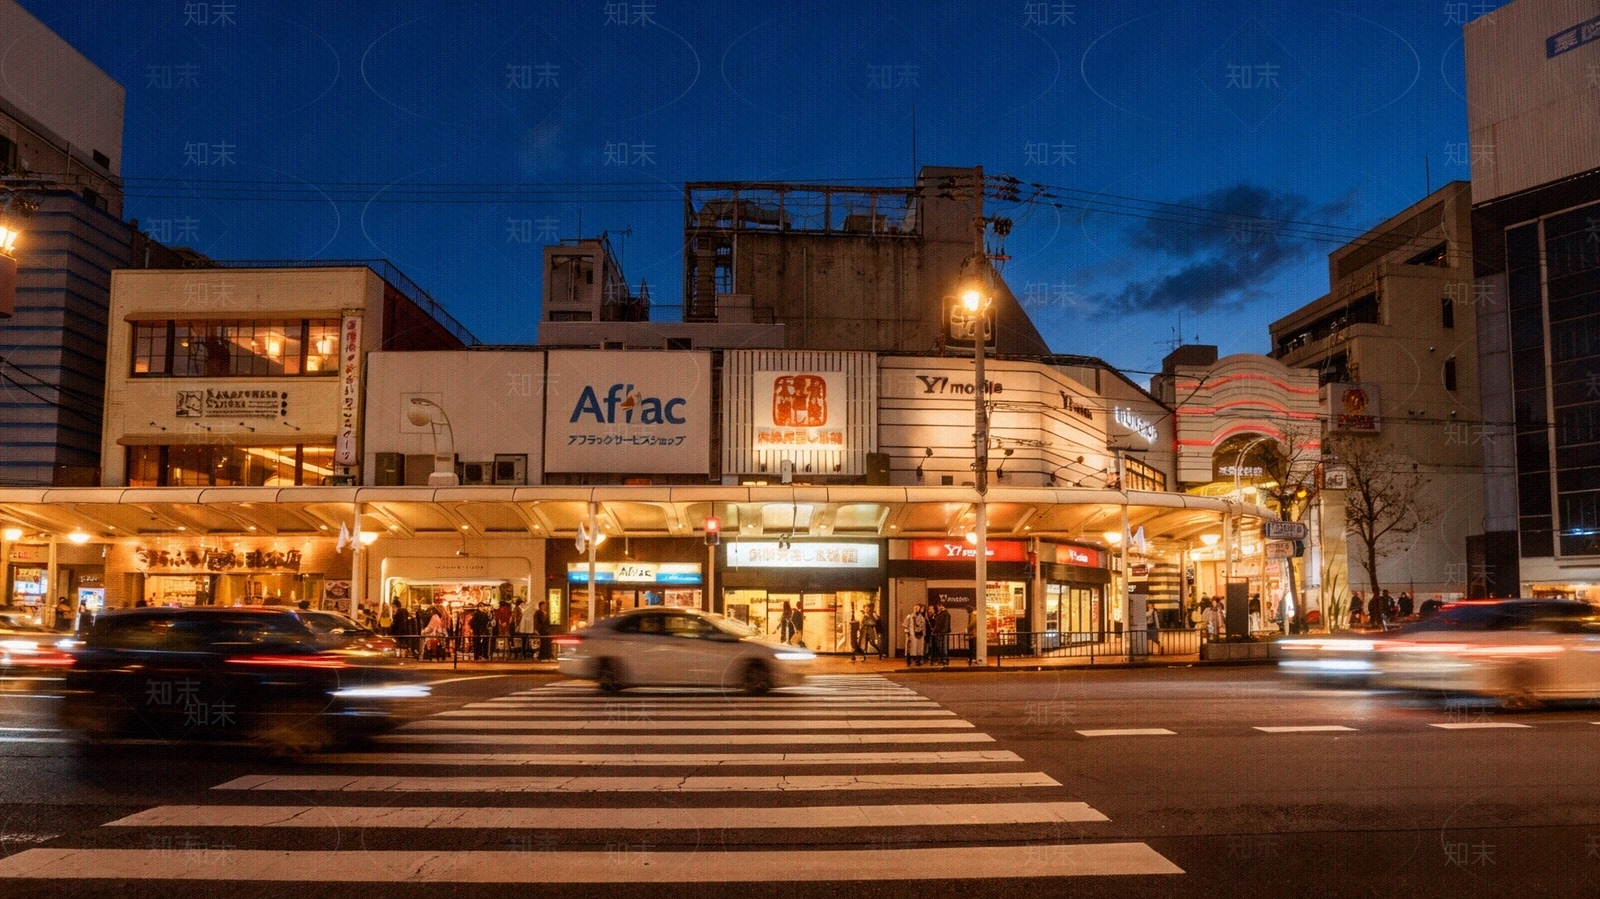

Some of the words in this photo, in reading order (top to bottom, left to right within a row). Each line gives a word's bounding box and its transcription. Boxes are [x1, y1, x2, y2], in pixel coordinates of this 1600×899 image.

[569, 383, 687, 424] Aflac
[568, 435, 687, 446] アフラックサービスショップ
